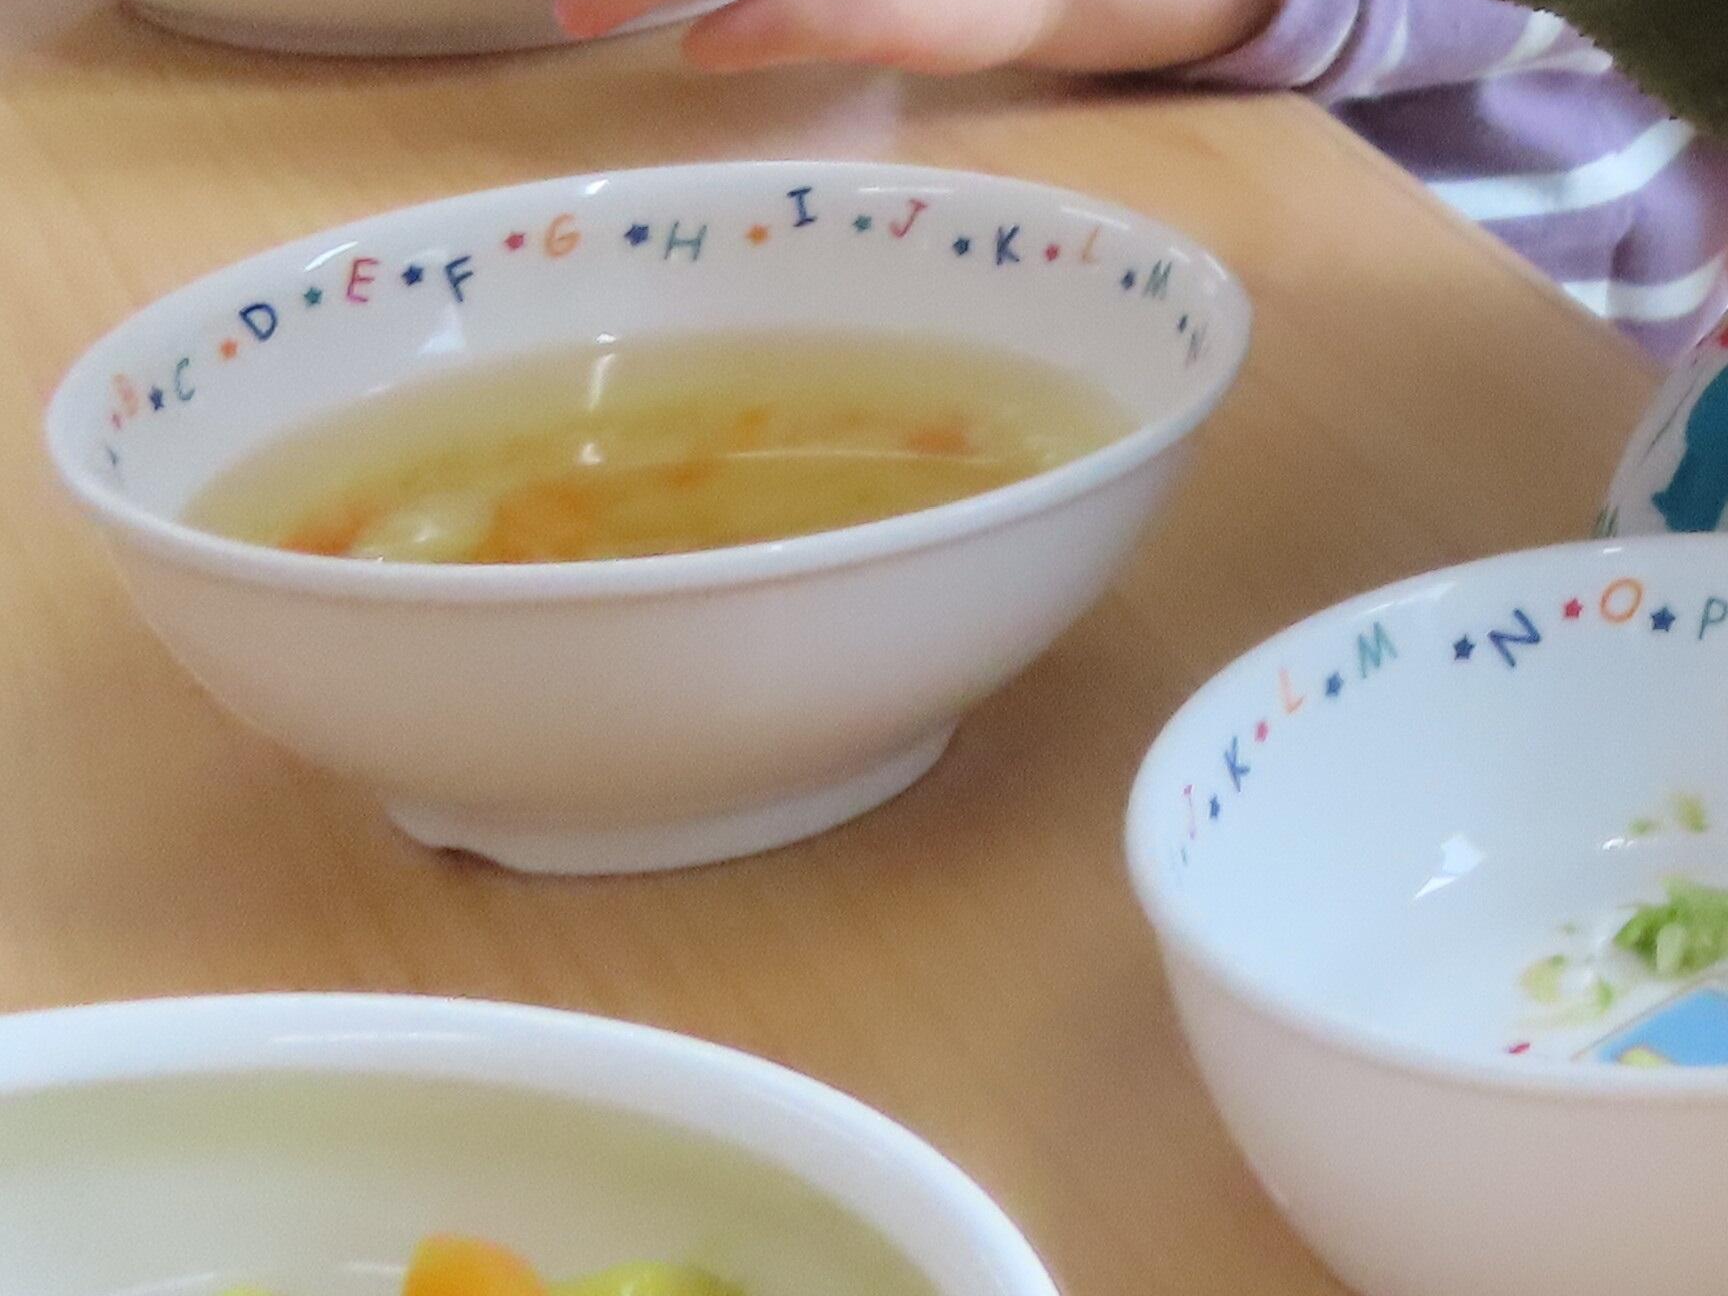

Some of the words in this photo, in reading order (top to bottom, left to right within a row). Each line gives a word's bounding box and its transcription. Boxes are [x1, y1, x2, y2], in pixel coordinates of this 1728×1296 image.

[174, 356, 196, 402] C
[239, 302, 279, 342] D
[345, 257, 381, 304] E
[444, 255, 474, 303] F
[544, 212, 580, 260] G
[663, 220, 708, 261] H
[786, 184, 818, 228] I
[889, 198, 929, 240] J
[995, 224, 1021, 266] K
[1224, 735, 1252, 794] K
[1276, 666, 1305, 715] L
[1357, 620, 1399, 680] M
[1487, 607, 1543, 669] N
[1598, 575, 1645, 626] O
[1697, 595, 1728, 641] P
